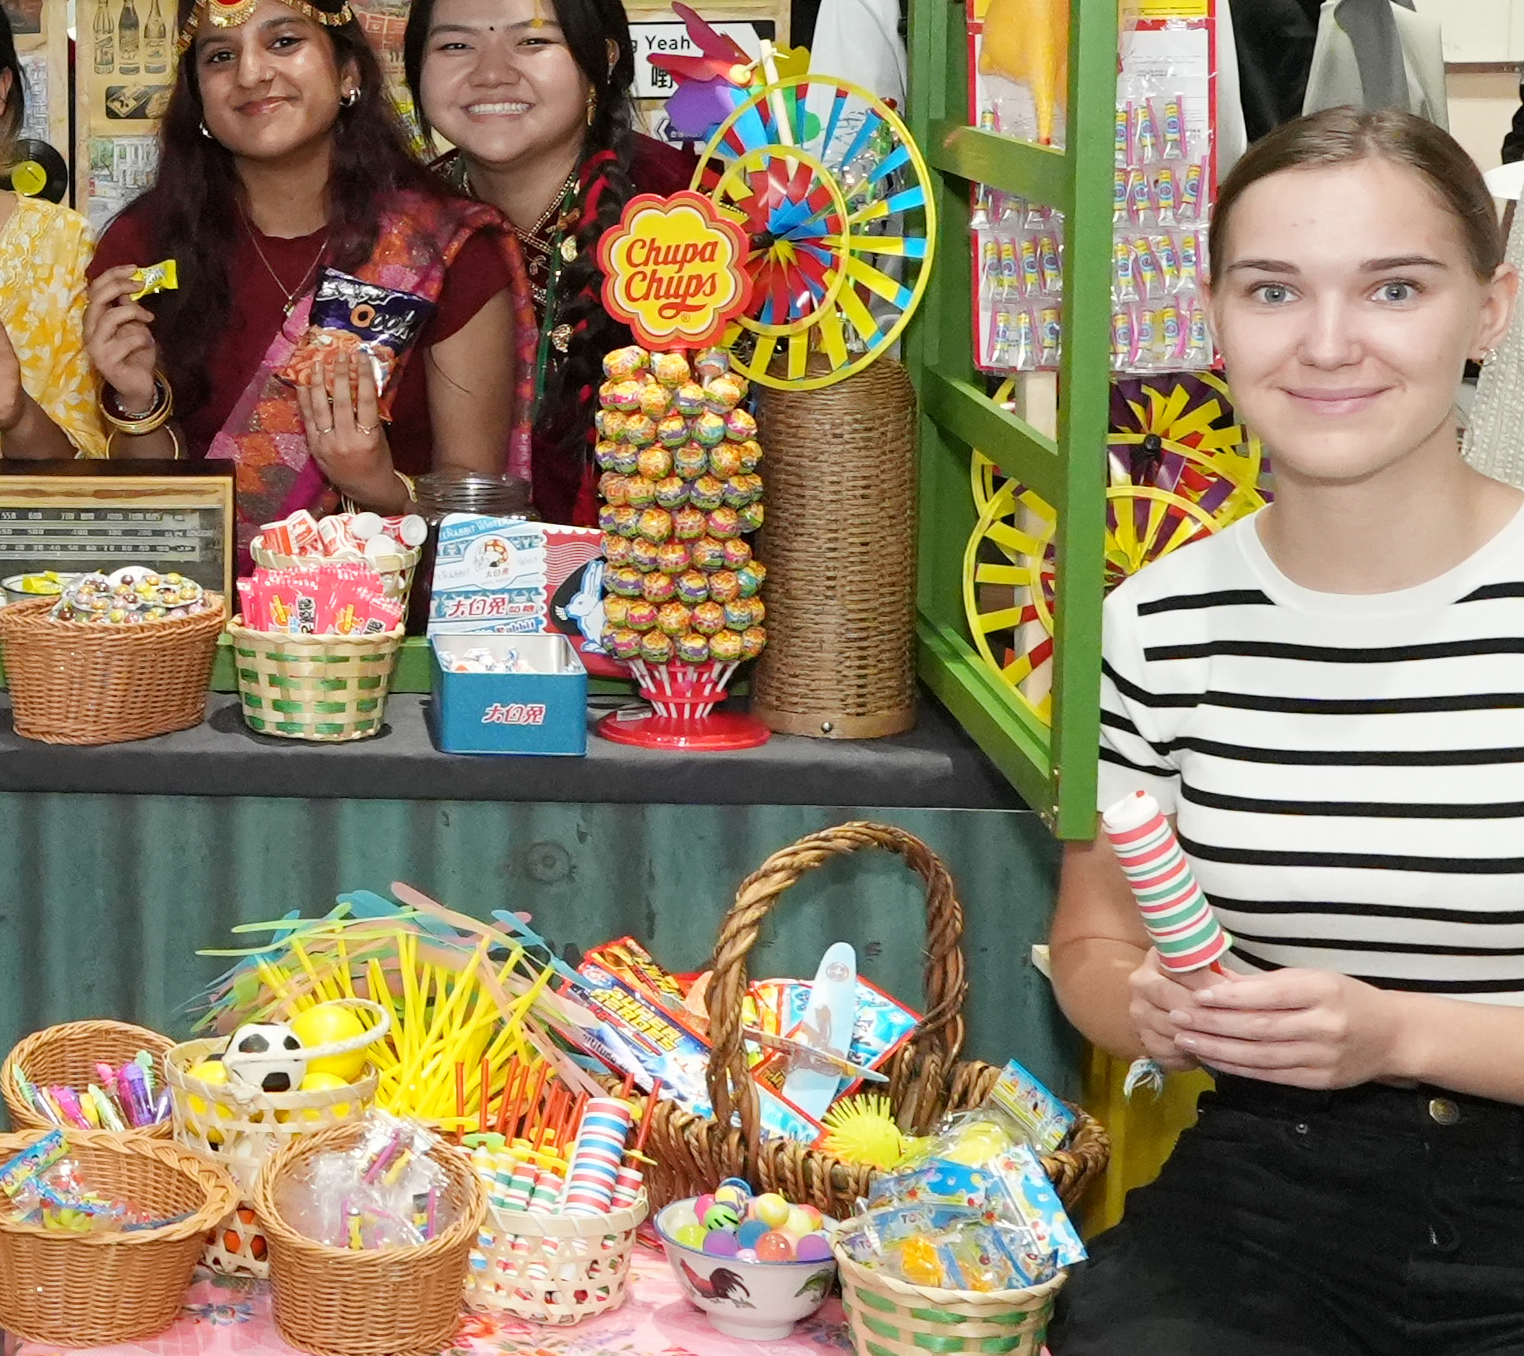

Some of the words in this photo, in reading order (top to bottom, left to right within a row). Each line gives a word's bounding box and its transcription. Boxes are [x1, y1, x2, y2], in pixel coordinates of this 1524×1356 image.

[645, 35, 691, 51] Yeah
[625, 237, 716, 276] Chupa
[624, 265, 718, 318] Chups
[481, 702, 547, 726] 大白兔
